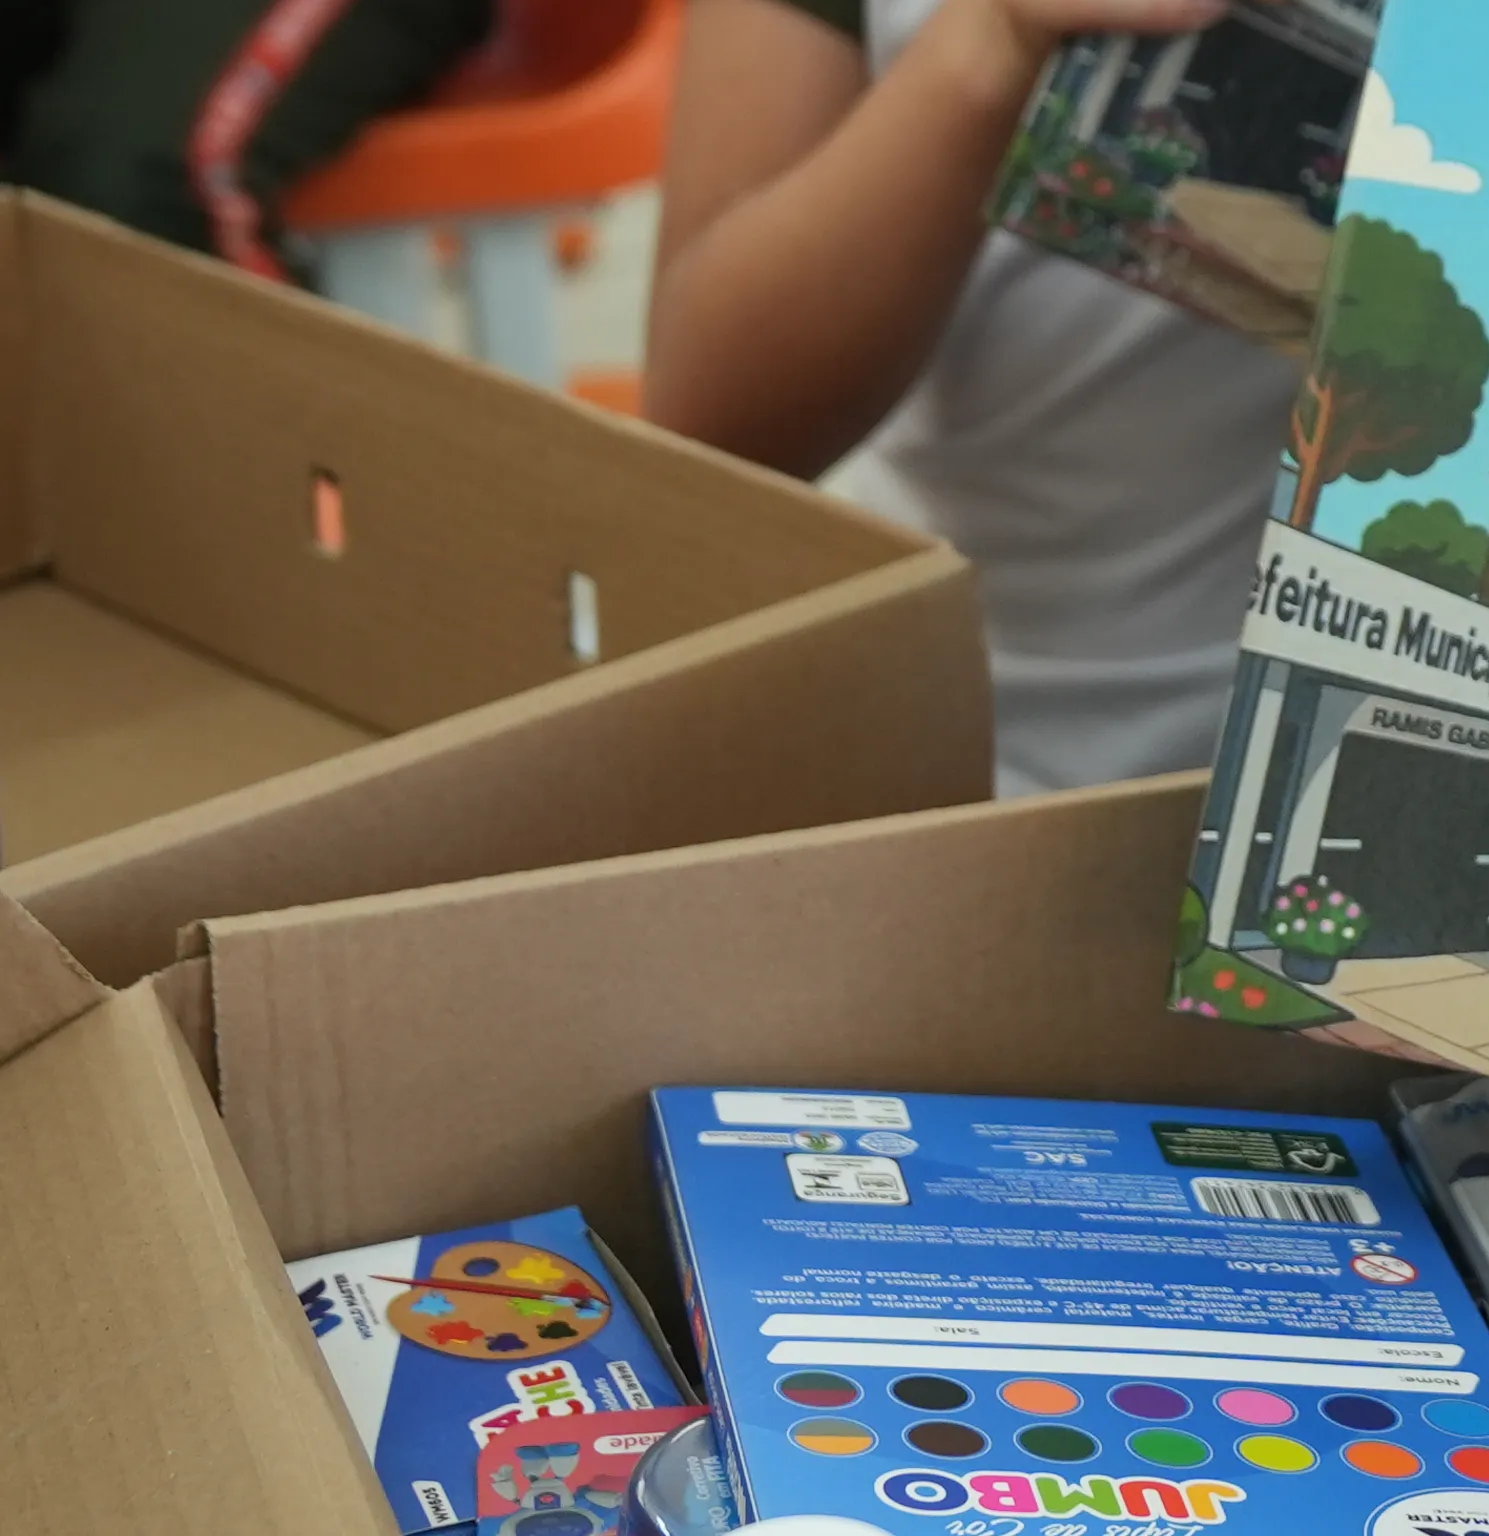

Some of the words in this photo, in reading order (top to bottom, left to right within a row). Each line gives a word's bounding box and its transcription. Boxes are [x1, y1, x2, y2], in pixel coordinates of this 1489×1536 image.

[1372, 707, 1442, 739] RAMIS
[1022, 1150, 1087, 1166] SAC
[1228, 1260, 1341, 1276] ATENÇÃO!
[1378, 1346, 1443, 1359] Escola:
[1398, 1373, 1460, 1387] Nome:
[703, 1456, 724, 1481] FITA
[883, 1472, 1238, 1521] JUMBO
[1405, 1511, 1487, 1526] MASTER
